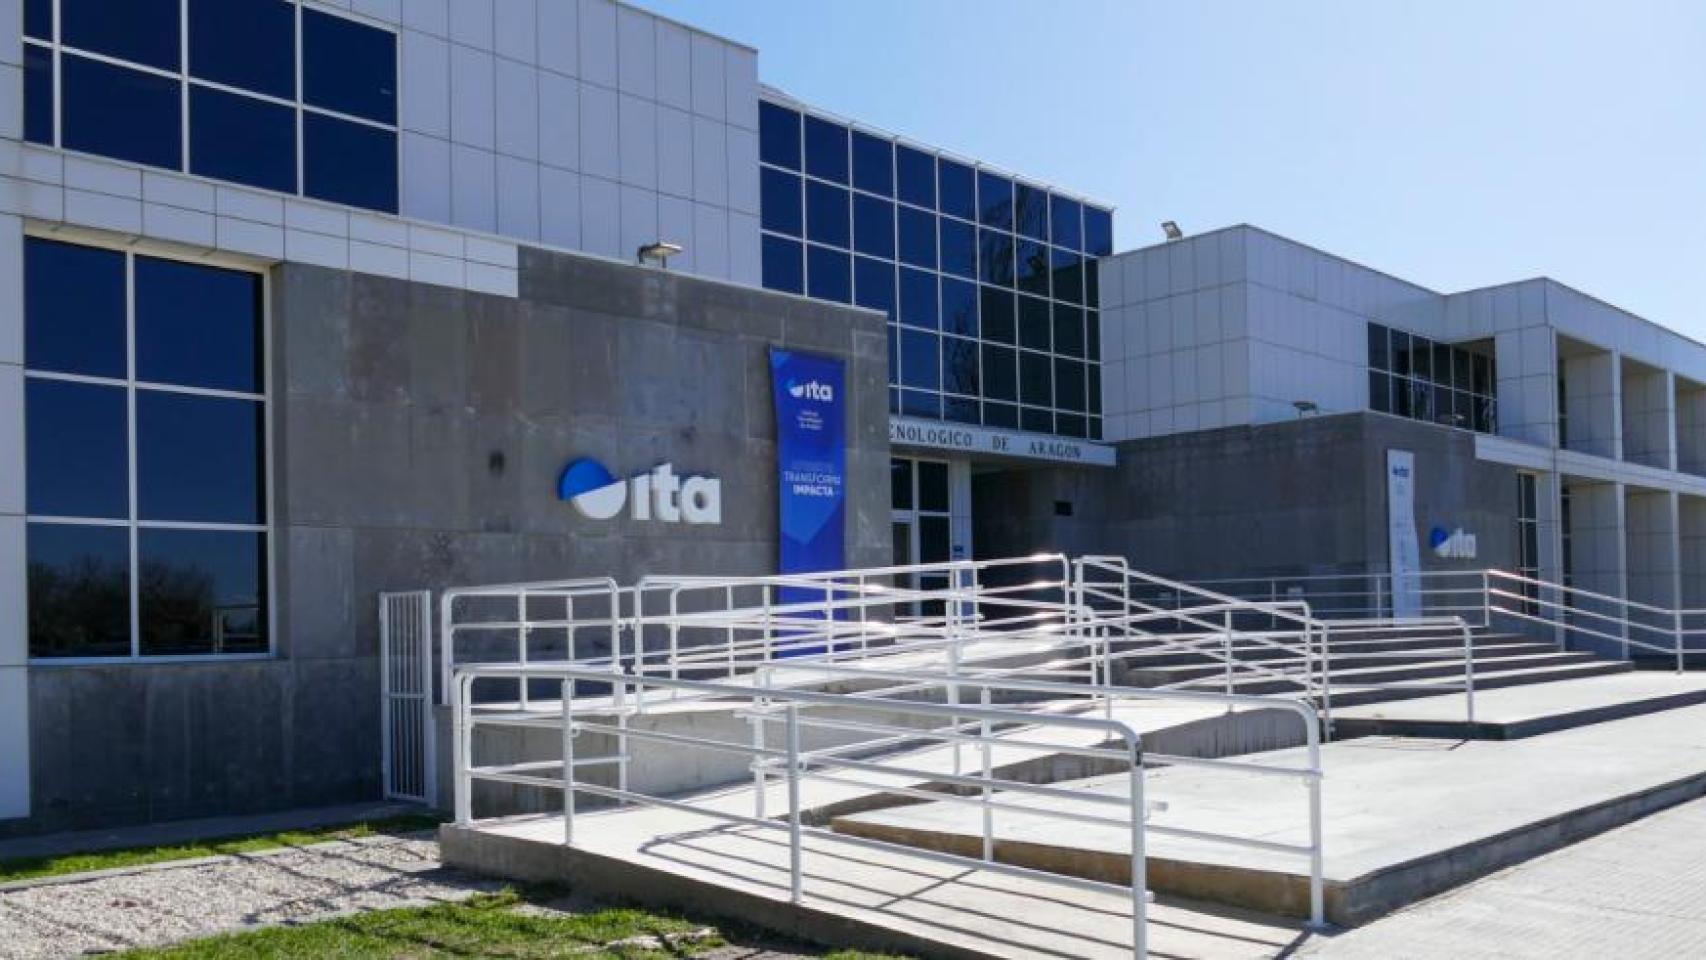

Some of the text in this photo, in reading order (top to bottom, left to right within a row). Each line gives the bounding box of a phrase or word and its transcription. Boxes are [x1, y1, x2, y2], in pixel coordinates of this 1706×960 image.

[992, 435, 1009, 452] DE
[630, 462, 721, 523] ita
[793, 483, 834, 495] IMPACTA
